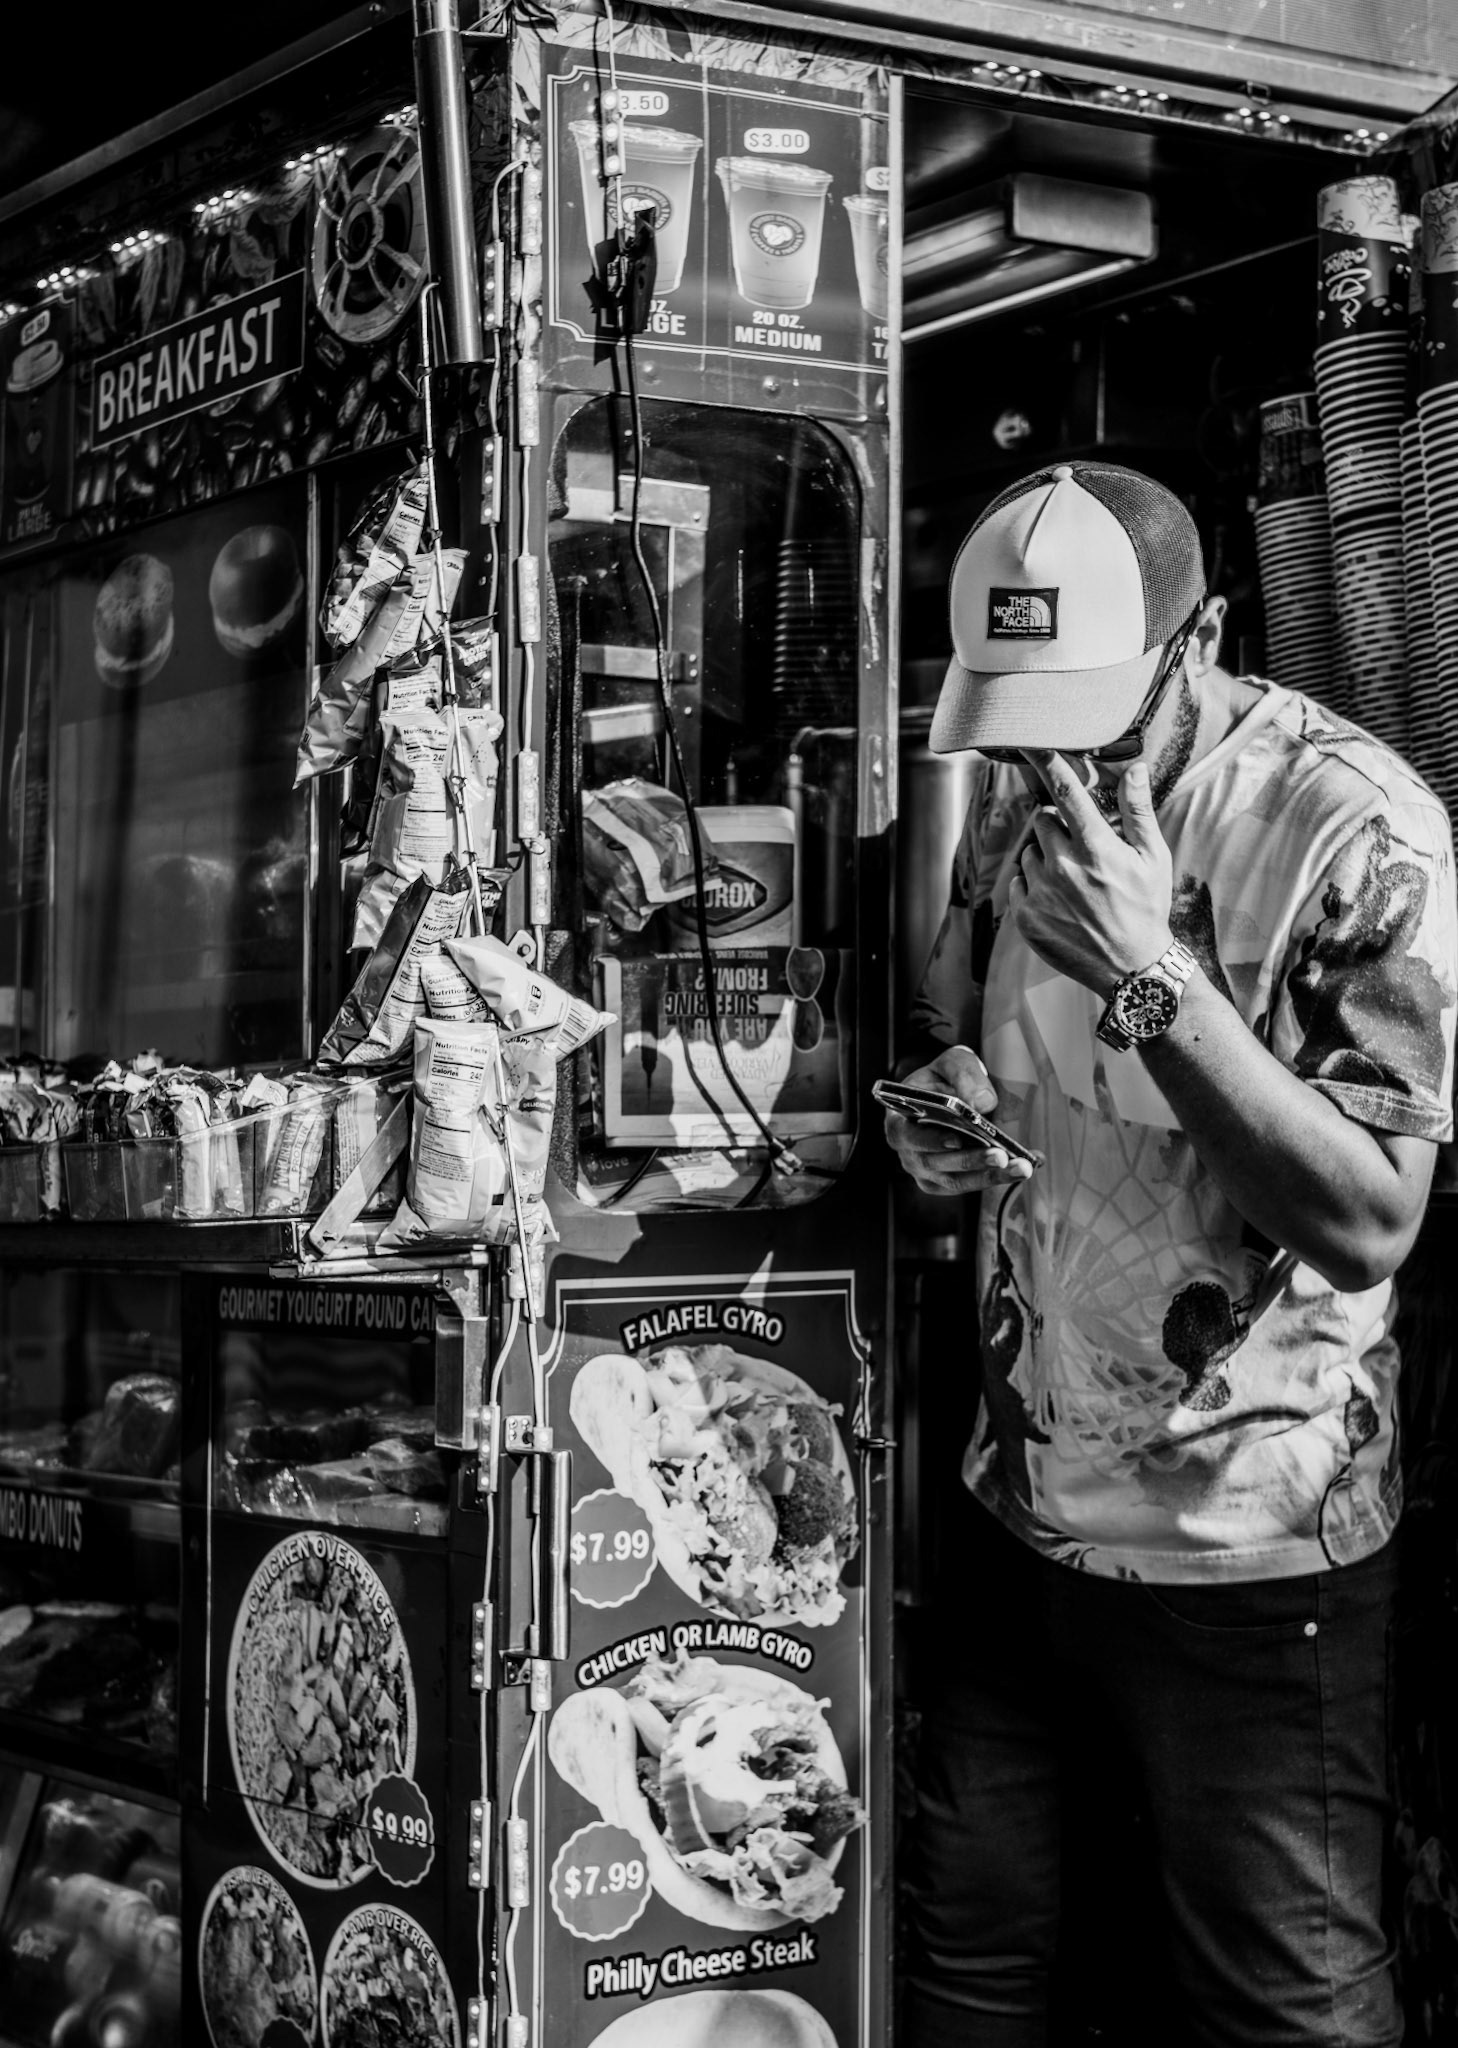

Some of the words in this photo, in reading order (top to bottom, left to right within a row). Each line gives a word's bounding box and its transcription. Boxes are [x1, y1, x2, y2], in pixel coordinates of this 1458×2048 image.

[620, 95, 664, 111] 3.50
[748, 132, 806, 150] $3.00
[600, 307, 687, 336] LGE
[752, 310, 775, 326] 20
[777, 312, 805, 329] OZ.
[734, 325, 823, 353] MEDIUM
[98, 297, 282, 432] BREAKFAST
[7, 512, 52, 542] LARGE
[993, 605, 1030, 617] NORTH
[1007, 595, 1030, 607] THE
[1002, 616, 1030, 627] FACE
[392, 691, 418, 700] Nutrition
[403, 728, 433, 736] Nutrition
[429, 989, 465, 997] Nutrition
[663, 991, 760, 1017] SUFFRING
[734, 1017, 768, 1041] ARE
[435, 1041, 470, 1051] Nutrition
[470, 1045, 488, 1055] Facts
[431, 1066, 459, 1077] Calories
[710, 1067, 768, 1080] ADVANED
[291, 1126, 310, 1173] PROTEIN
[599, 1154, 630, 1172] love
[272, 1144, 293, 1188] NATURE
[219, 1286, 284, 1322] GOURMET
[286, 1290, 353, 1326] YOUGURT
[355, 1293, 407, 1330] POUND
[623, 1305, 719, 1350] FALAFEL
[723, 1305, 784, 1342] GYRO
[29, 1493, 83, 1553] DONUTS
[570, 1529, 650, 1565] $7.99
[249, 1534, 310, 1613] CHICKEN
[313, 1535, 358, 1576] OVER
[359, 1565, 395, 1632] RICE
[577, 1630, 666, 1687] CHICKEN
[672, 1625, 703, 1649] OR
[704, 1625, 760, 1651] LAMB
[760, 1631, 813, 1671] GYRO
[371, 1806, 430, 1848] $9.99
[564, 1859, 645, 1900] $7.99
[341, 1910, 375, 1944] LAMB
[376, 1909, 410, 1937] OVER
[410, 1927, 438, 1970] RICE
[586, 1950, 658, 1995] Philly
[660, 1943, 746, 1984] Cheese
[750, 1932, 817, 1967] Steak
